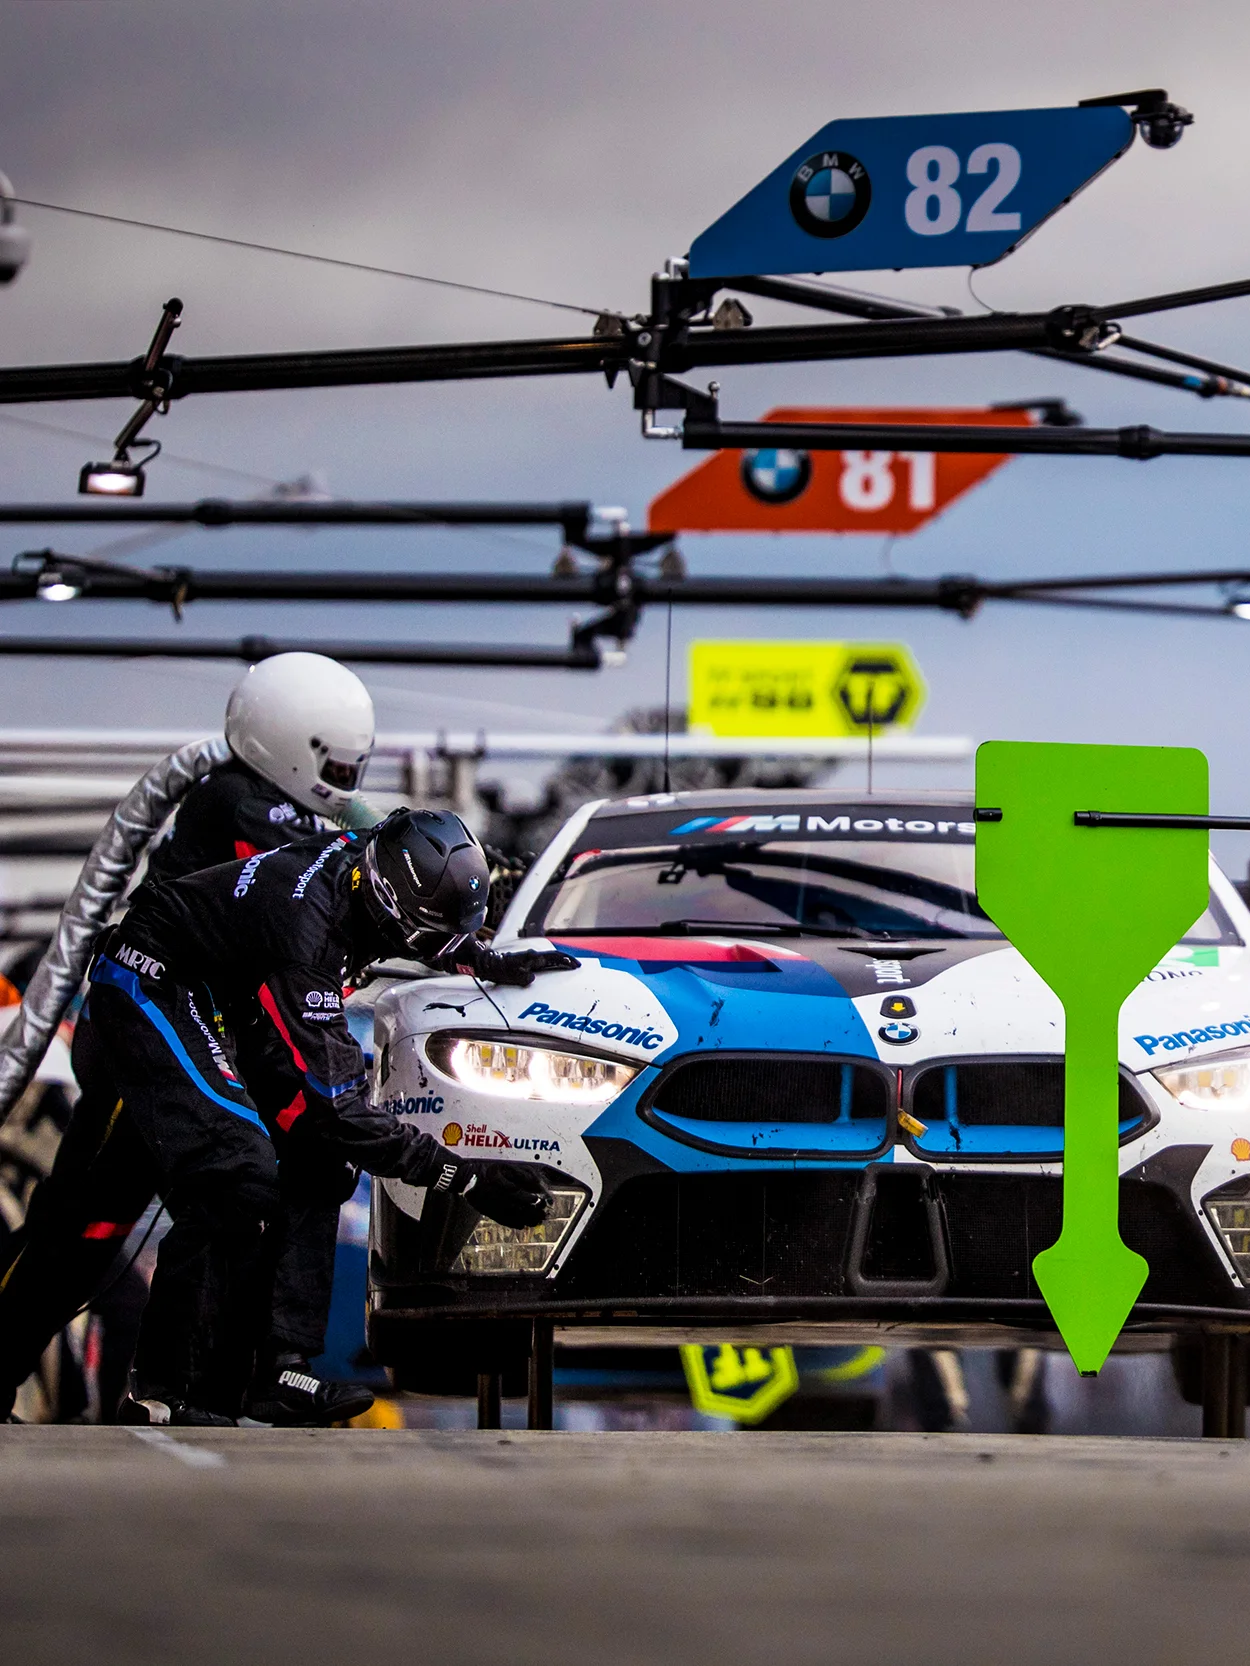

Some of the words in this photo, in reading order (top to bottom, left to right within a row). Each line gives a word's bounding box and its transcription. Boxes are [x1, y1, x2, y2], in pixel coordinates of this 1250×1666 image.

[797, 153, 866, 182] BMW
[904, 142, 1022, 236] 82
[840, 450, 937, 512] 81
[806, 815, 976, 834] Motors
[292, 845, 331, 898] Motorsport
[115, 943, 166, 979] MRTC
[517, 1002, 664, 1050] Panasonic
[464, 1130, 513, 1148] HELIX
[513, 1139, 561, 1151] ULTRA
[466, 1124, 487, 1133] Shell
[278, 1370, 320, 1394] PUMA
